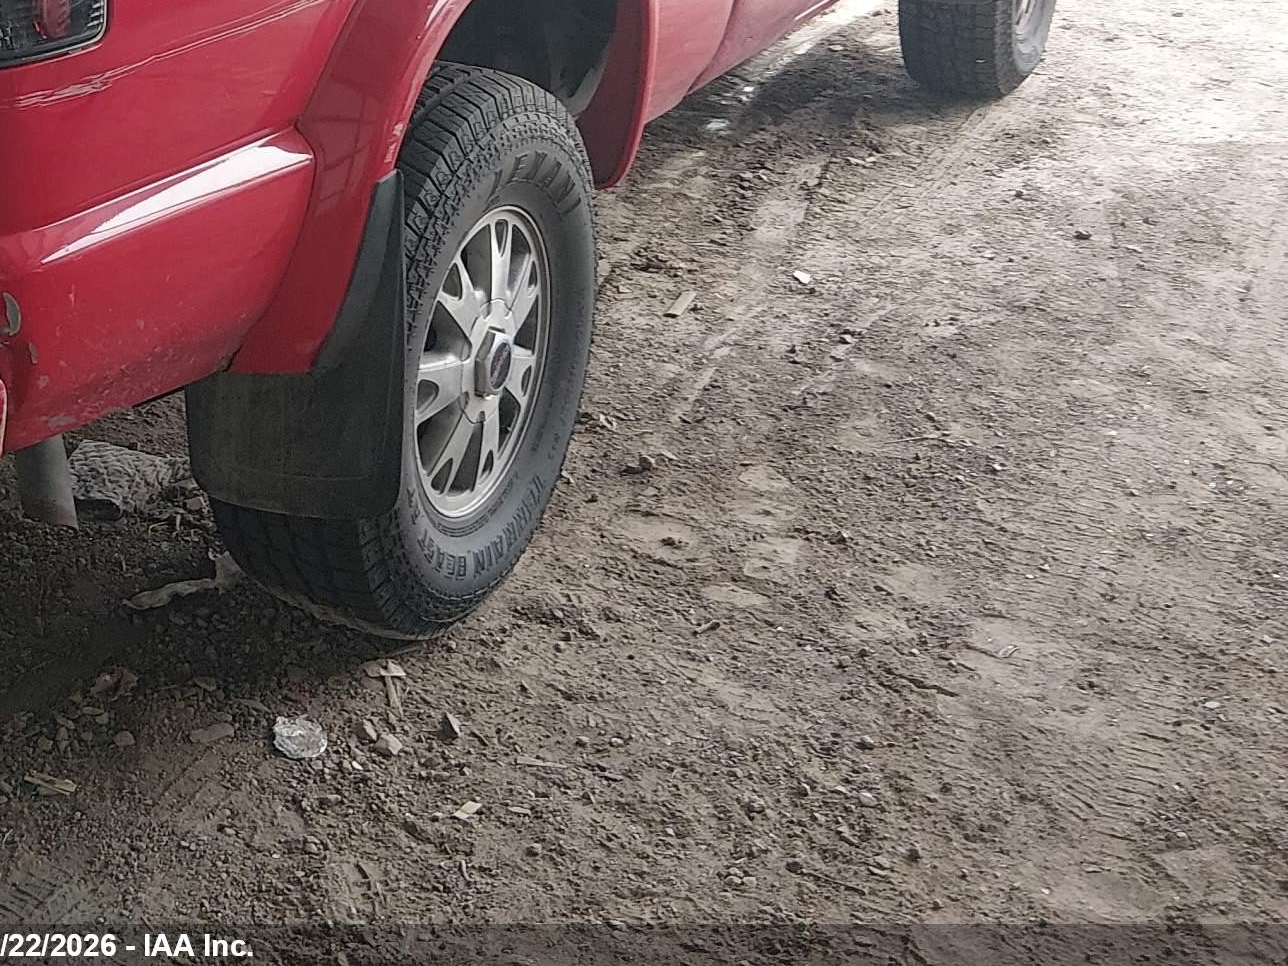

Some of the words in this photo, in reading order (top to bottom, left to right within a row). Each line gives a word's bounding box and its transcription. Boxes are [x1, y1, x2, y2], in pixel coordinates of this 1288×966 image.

[482, 150, 582, 212] LEXANI
[417, 529, 467, 581] BEAST
[473, 474, 547, 577] TERRAIN
